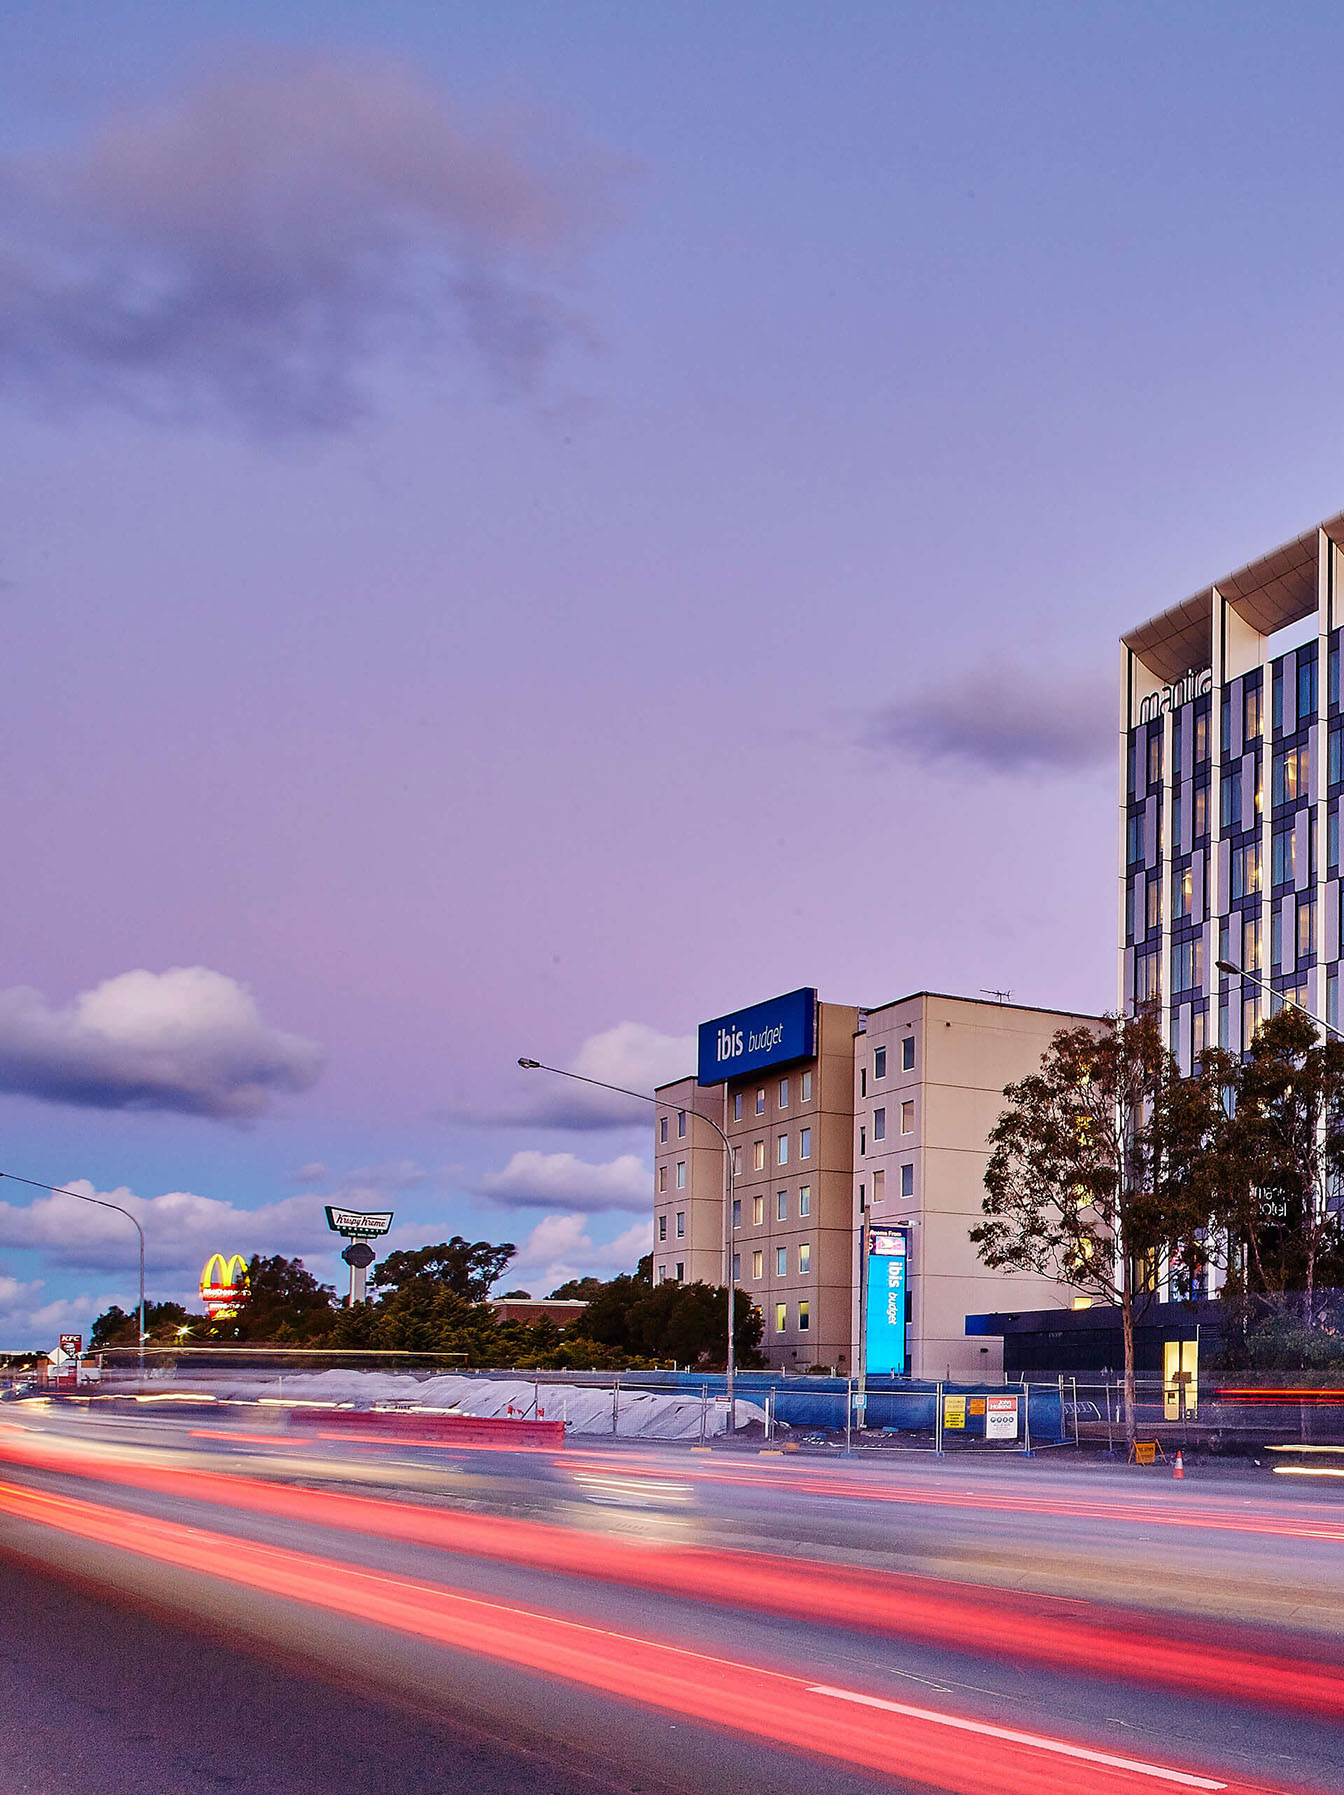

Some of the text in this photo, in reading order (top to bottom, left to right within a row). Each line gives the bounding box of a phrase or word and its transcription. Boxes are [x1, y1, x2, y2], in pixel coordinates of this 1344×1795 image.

[1140, 667, 1212, 725] mantra
[716, 1023, 784, 1062] ibis budget
[1257, 1201, 1287, 1217] otel
[886, 1261, 904, 1325] ibis budget
